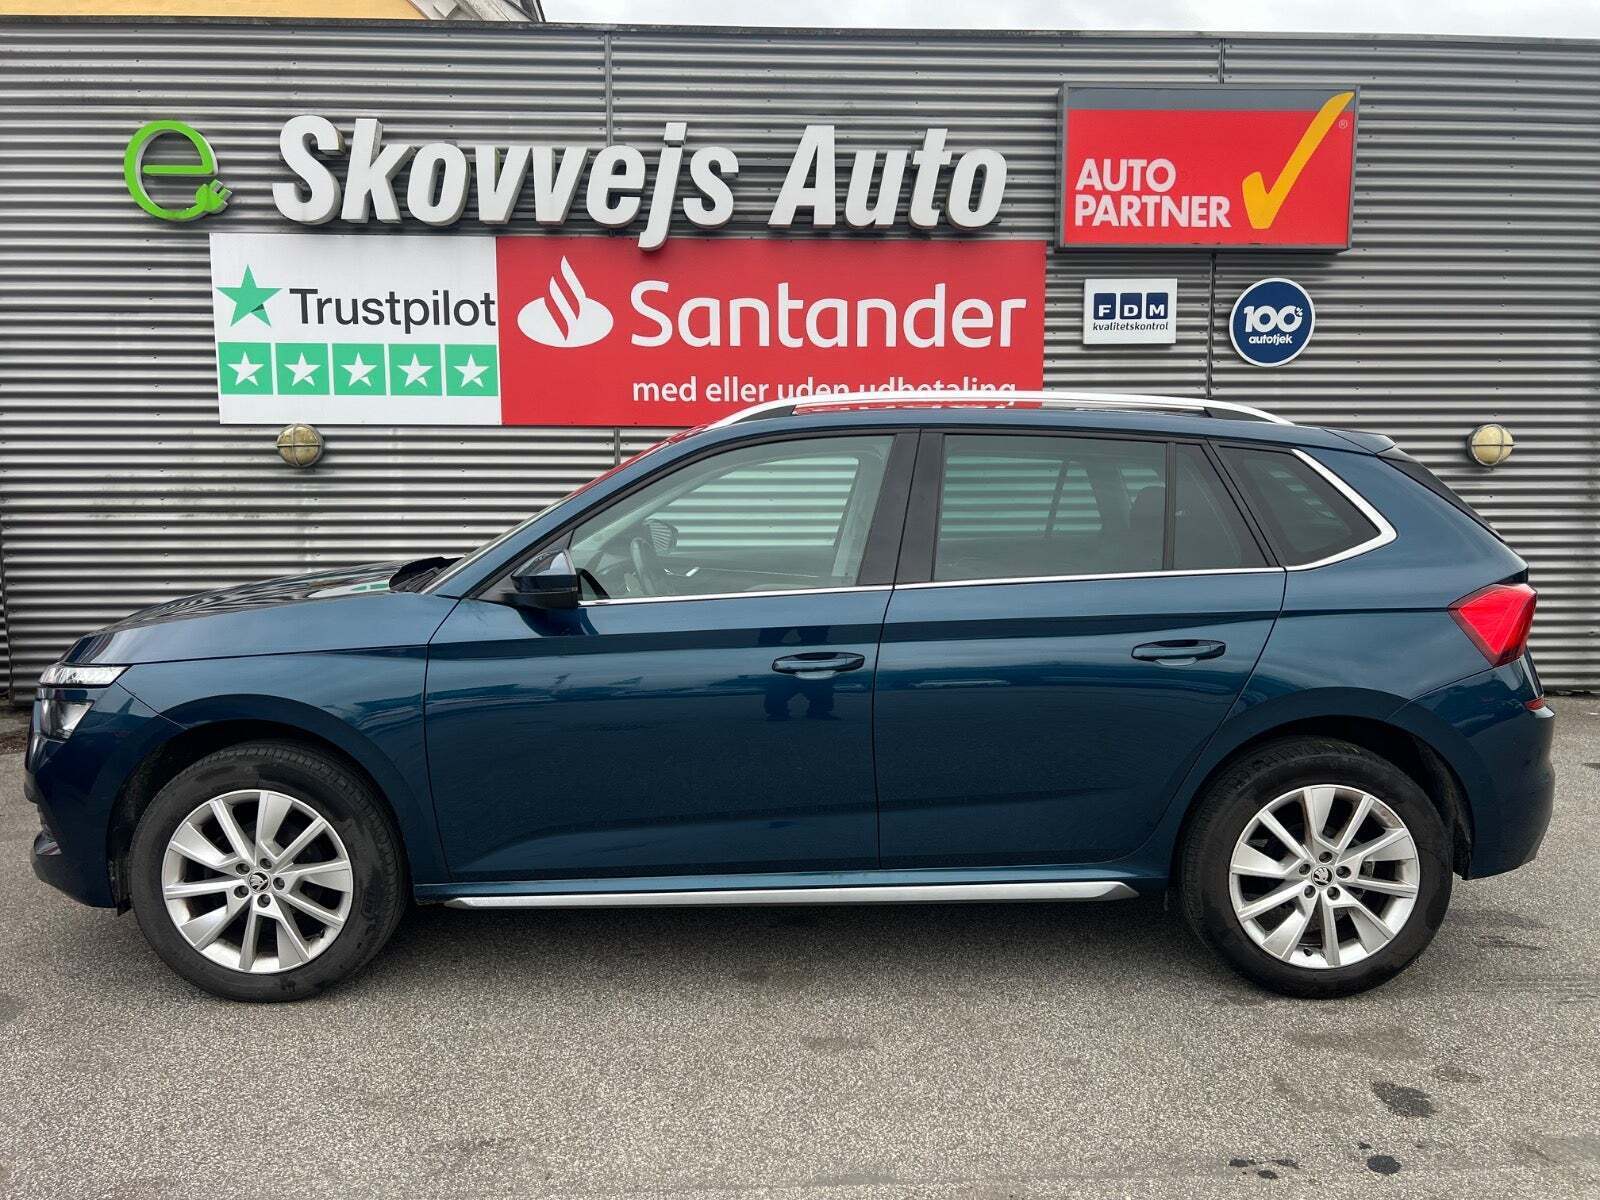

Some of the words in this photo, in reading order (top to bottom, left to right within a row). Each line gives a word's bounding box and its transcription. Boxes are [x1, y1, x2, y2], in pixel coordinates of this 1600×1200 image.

[272, 115, 739, 251] Skovvejs
[767, 125, 1008, 230] Auto
[1075, 158, 1177, 192] AUTO
[1075, 194, 1232, 228] PARTNER
[289, 288, 496, 334] Trustpilot
[631, 280, 1026, 348] Santander
[1093, 321, 1169, 331] kvalitetskontrol
[1097, 303, 1166, 318] FDM
[1249, 333, 1293, 346] autotjek
[632, 375, 696, 402] med
[705, 375, 769, 402] eller
[777, 376, 849, 400] uden
